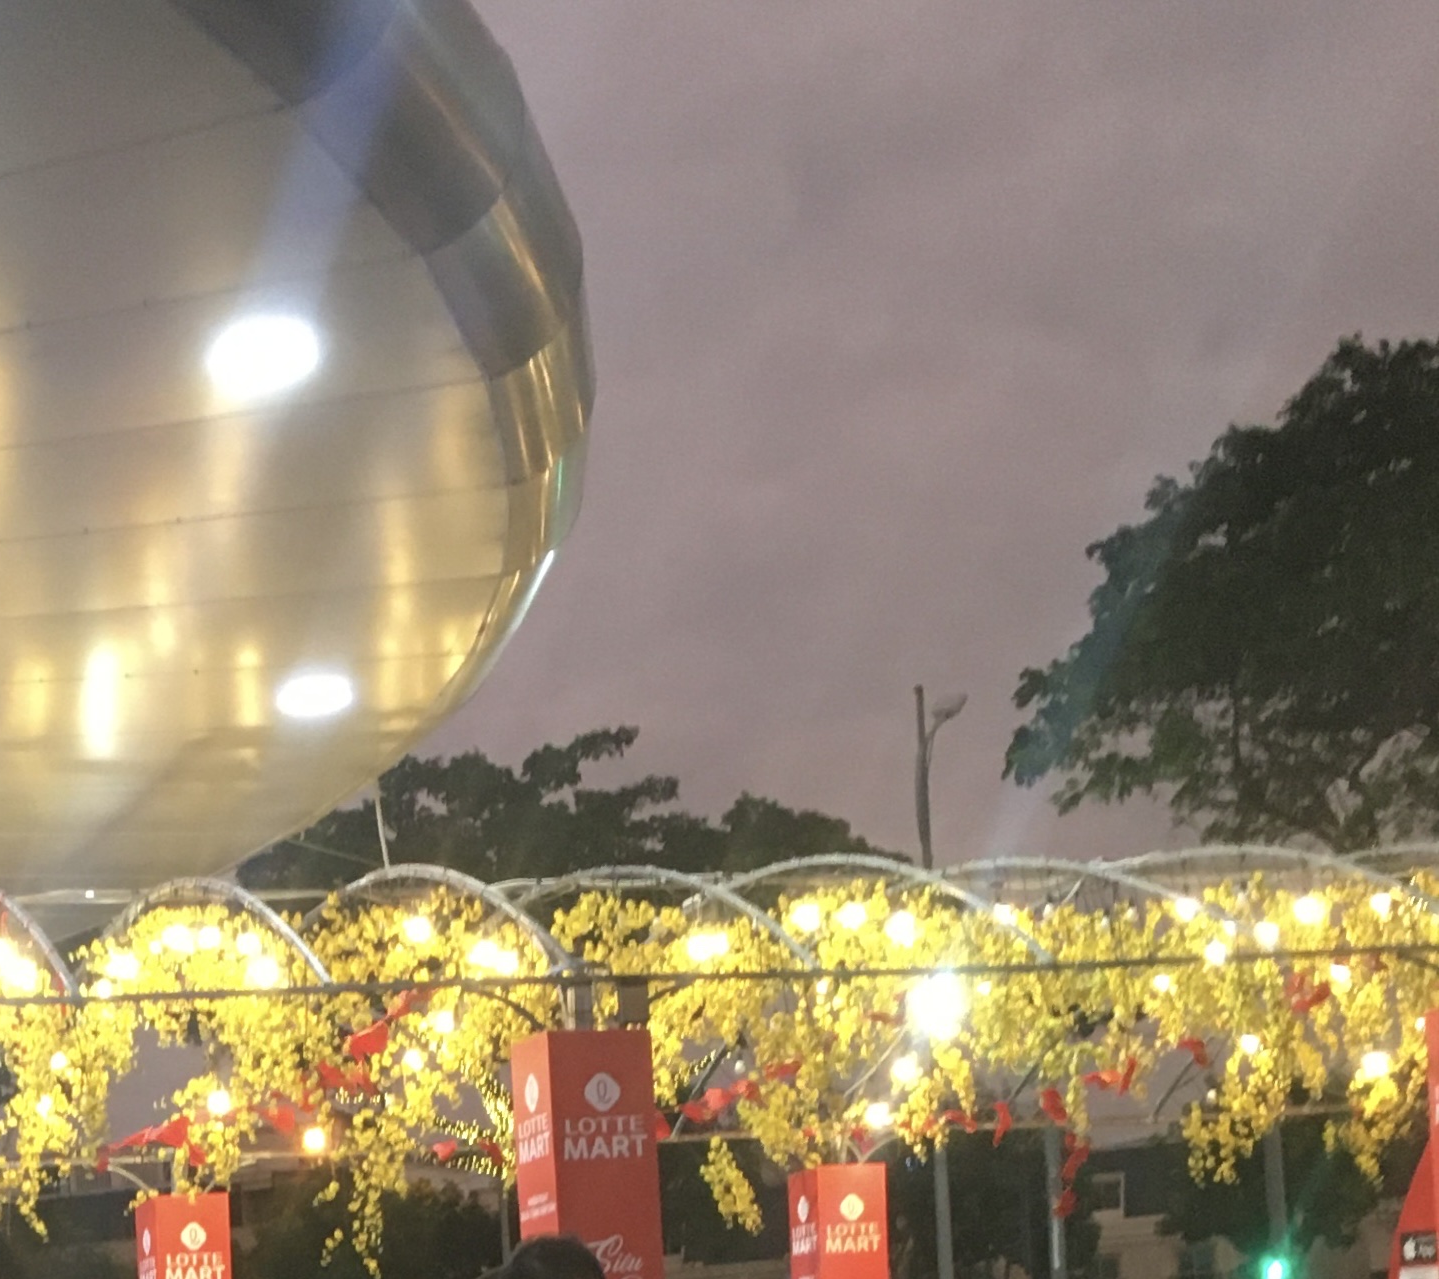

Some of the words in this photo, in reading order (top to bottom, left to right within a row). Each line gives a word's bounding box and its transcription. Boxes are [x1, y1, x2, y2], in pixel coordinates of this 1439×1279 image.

[517, 1111, 549, 1140] LOTTE
[563, 1113, 645, 1136] LOTTE
[518, 1131, 550, 1166] MART
[563, 1132, 648, 1162] MART
[825, 1221, 880, 1236] LOTTE
[825, 1233, 882, 1254] MART
[166, 1252, 224, 1268] LOTTE
